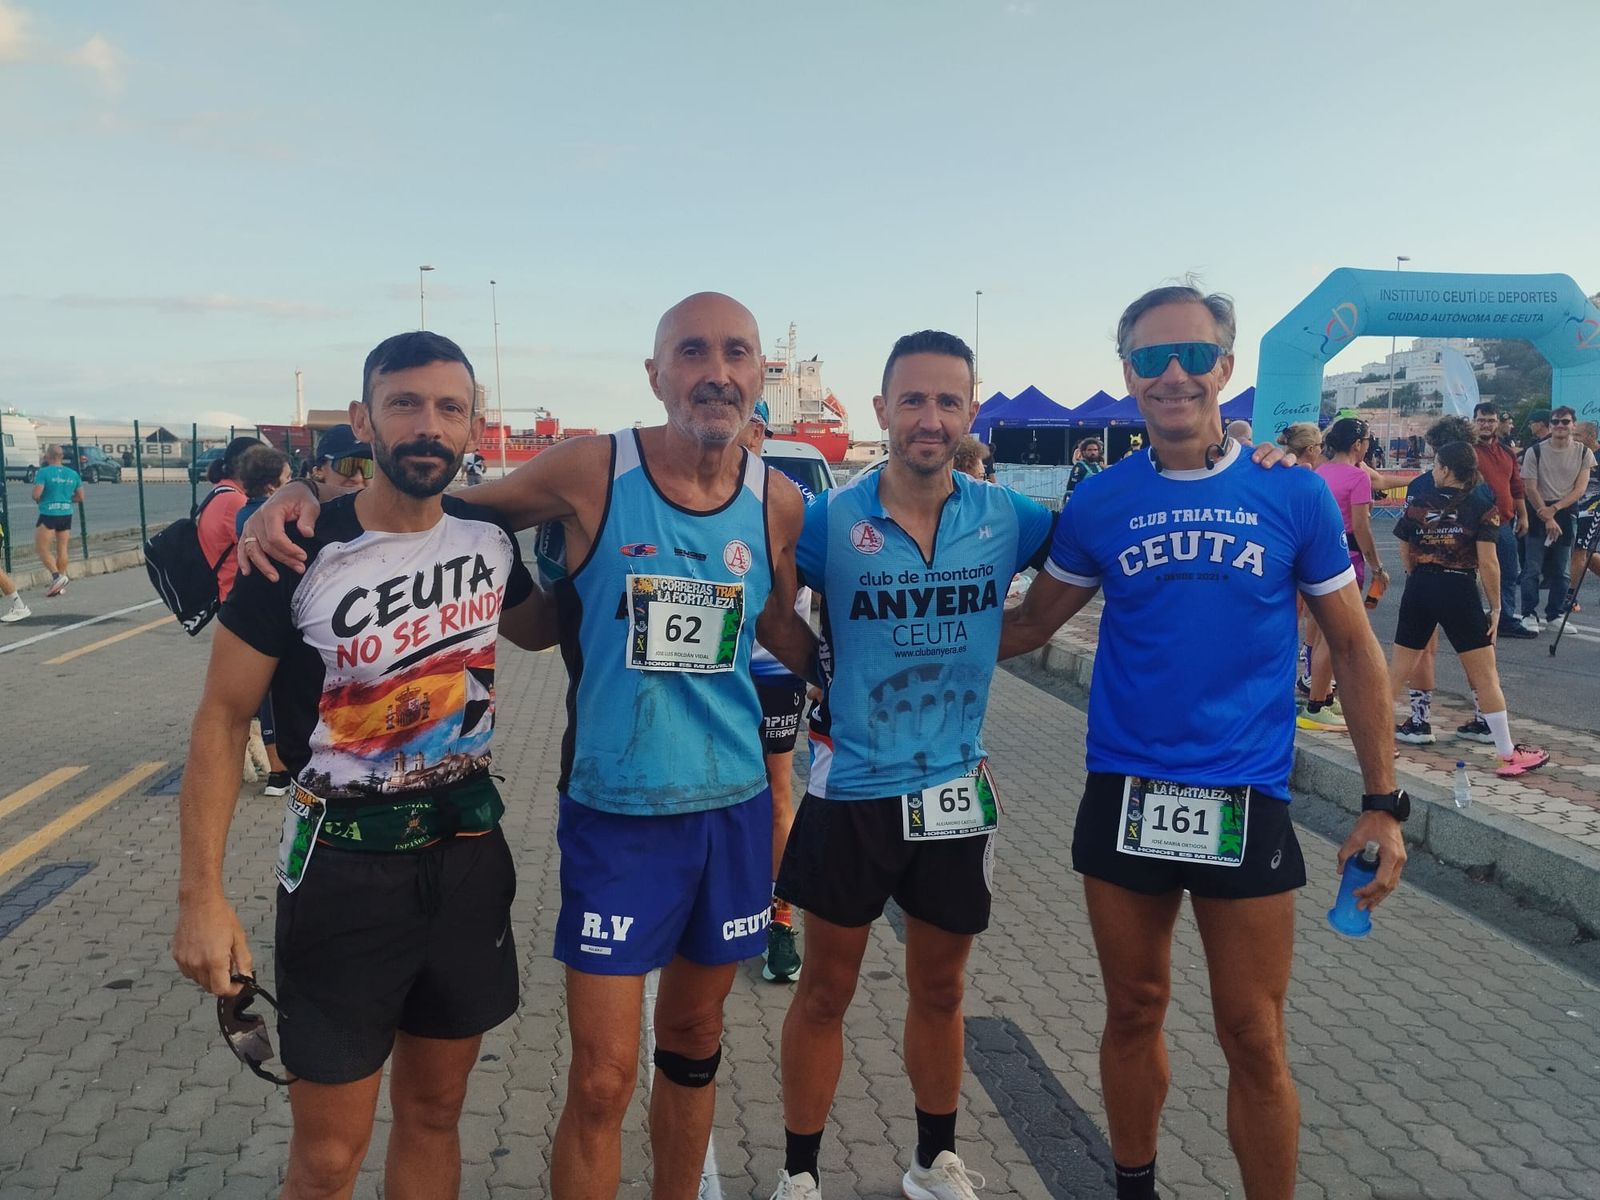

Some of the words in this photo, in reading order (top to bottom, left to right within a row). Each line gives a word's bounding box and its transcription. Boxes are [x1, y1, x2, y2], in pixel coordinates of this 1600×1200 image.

[1380, 289, 1440, 302] INSTITUTO
[1480, 291, 1495, 303] DE
[1498, 291, 1558, 304] DEPORTES
[1388, 312, 1428, 322] CIUDAD
[1493, 313, 1507, 323] DE
[1509, 313, 1544, 323] CEUTA
[1130, 511, 1167, 529] CLUB
[1172, 507, 1258, 525] TRIATLÓN
[1118, 530, 1265, 577] CEUTA
[860, 571, 893, 586] club
[898, 570, 919, 584] de
[925, 564, 993, 583] montaña
[331, 552, 497, 638] CEUTA
[657, 591, 671, 602] LA
[672, 591, 735, 609] FORTALEZA
[849, 579, 998, 621] ANYERA
[665, 614, 702, 644] 62
[893, 620, 968, 647] CEUTA
[336, 634, 382, 670] NO
[393, 614, 431, 654] SE
[895, 645, 967, 658] www.clubanyera.es
[939, 787, 970, 813] 65
[1153, 784, 1167, 795] LA
[1168, 785, 1232, 801] FORTALEZA
[1151, 804, 1210, 836] 161
[1138, 847, 1174, 856] HONOR
[1181, 842, 1207, 850] ORTIGOSA
[581, 911, 634, 941] R.V
